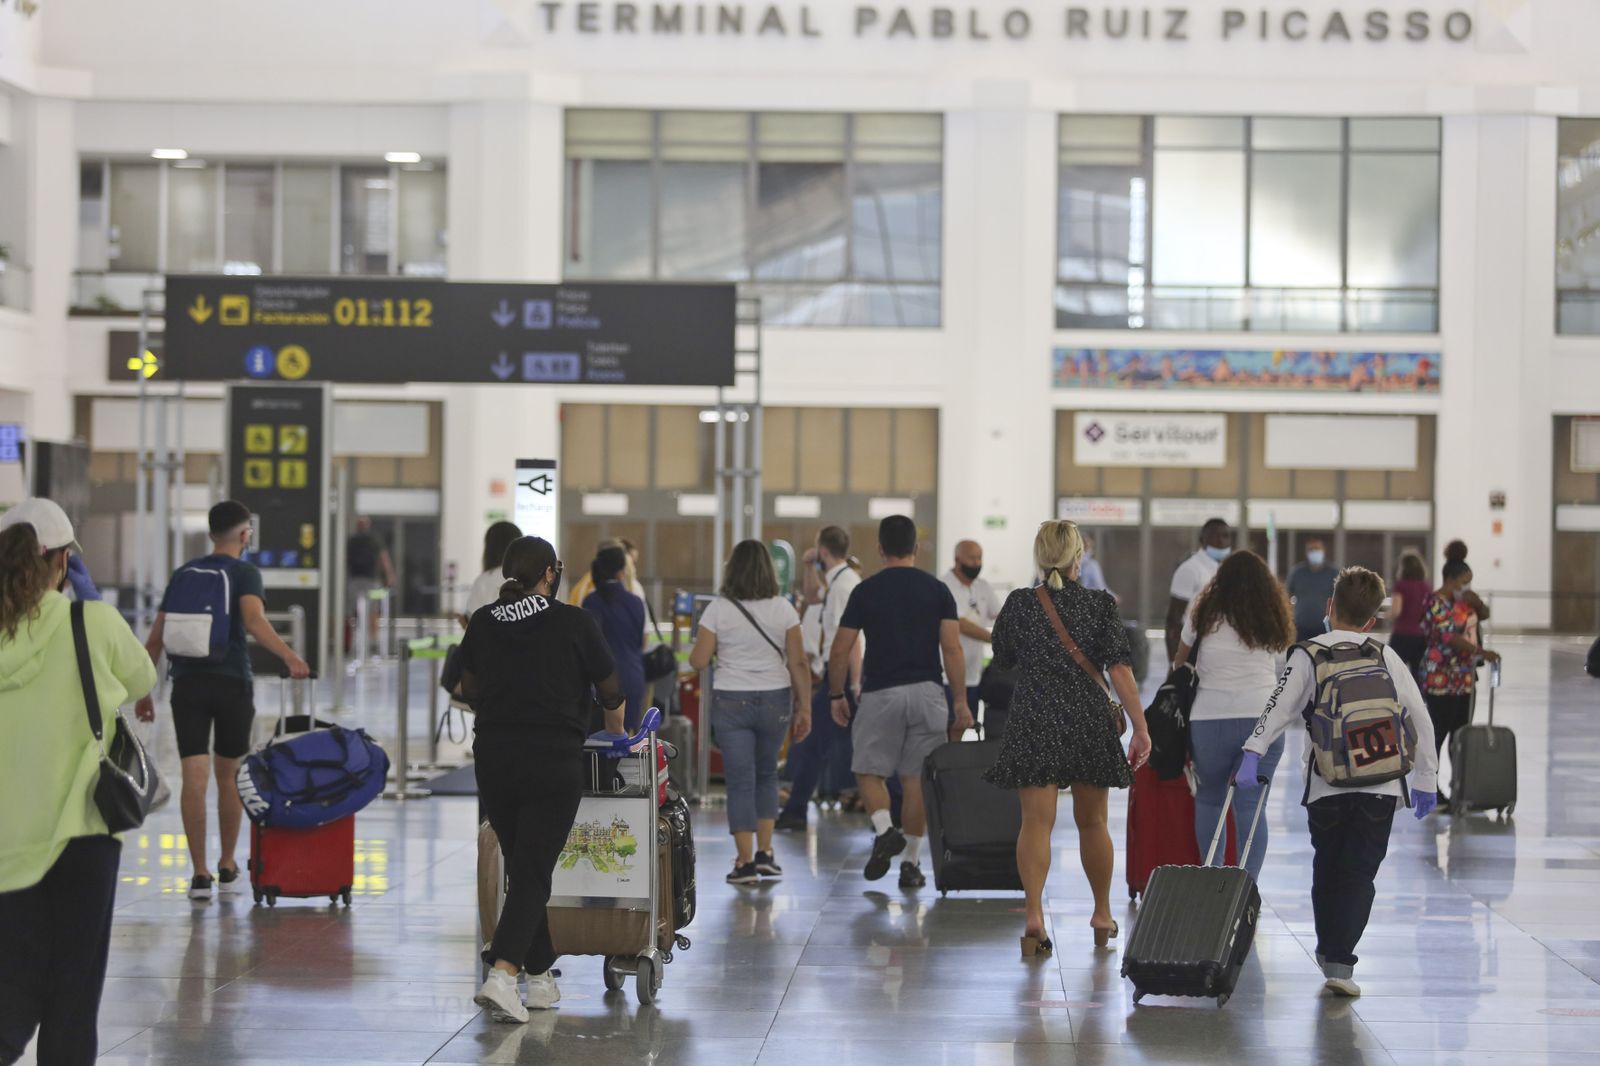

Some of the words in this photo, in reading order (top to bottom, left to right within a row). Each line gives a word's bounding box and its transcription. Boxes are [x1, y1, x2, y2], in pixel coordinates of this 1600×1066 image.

[539, 2, 821, 38] TERMINAL
[855, 7, 1032, 40] PABLO
[1065, 8, 1189, 41] RUIZ
[1222, 10, 1474, 43] PICASSO
[499, 594, 550, 622] EXCUSE
